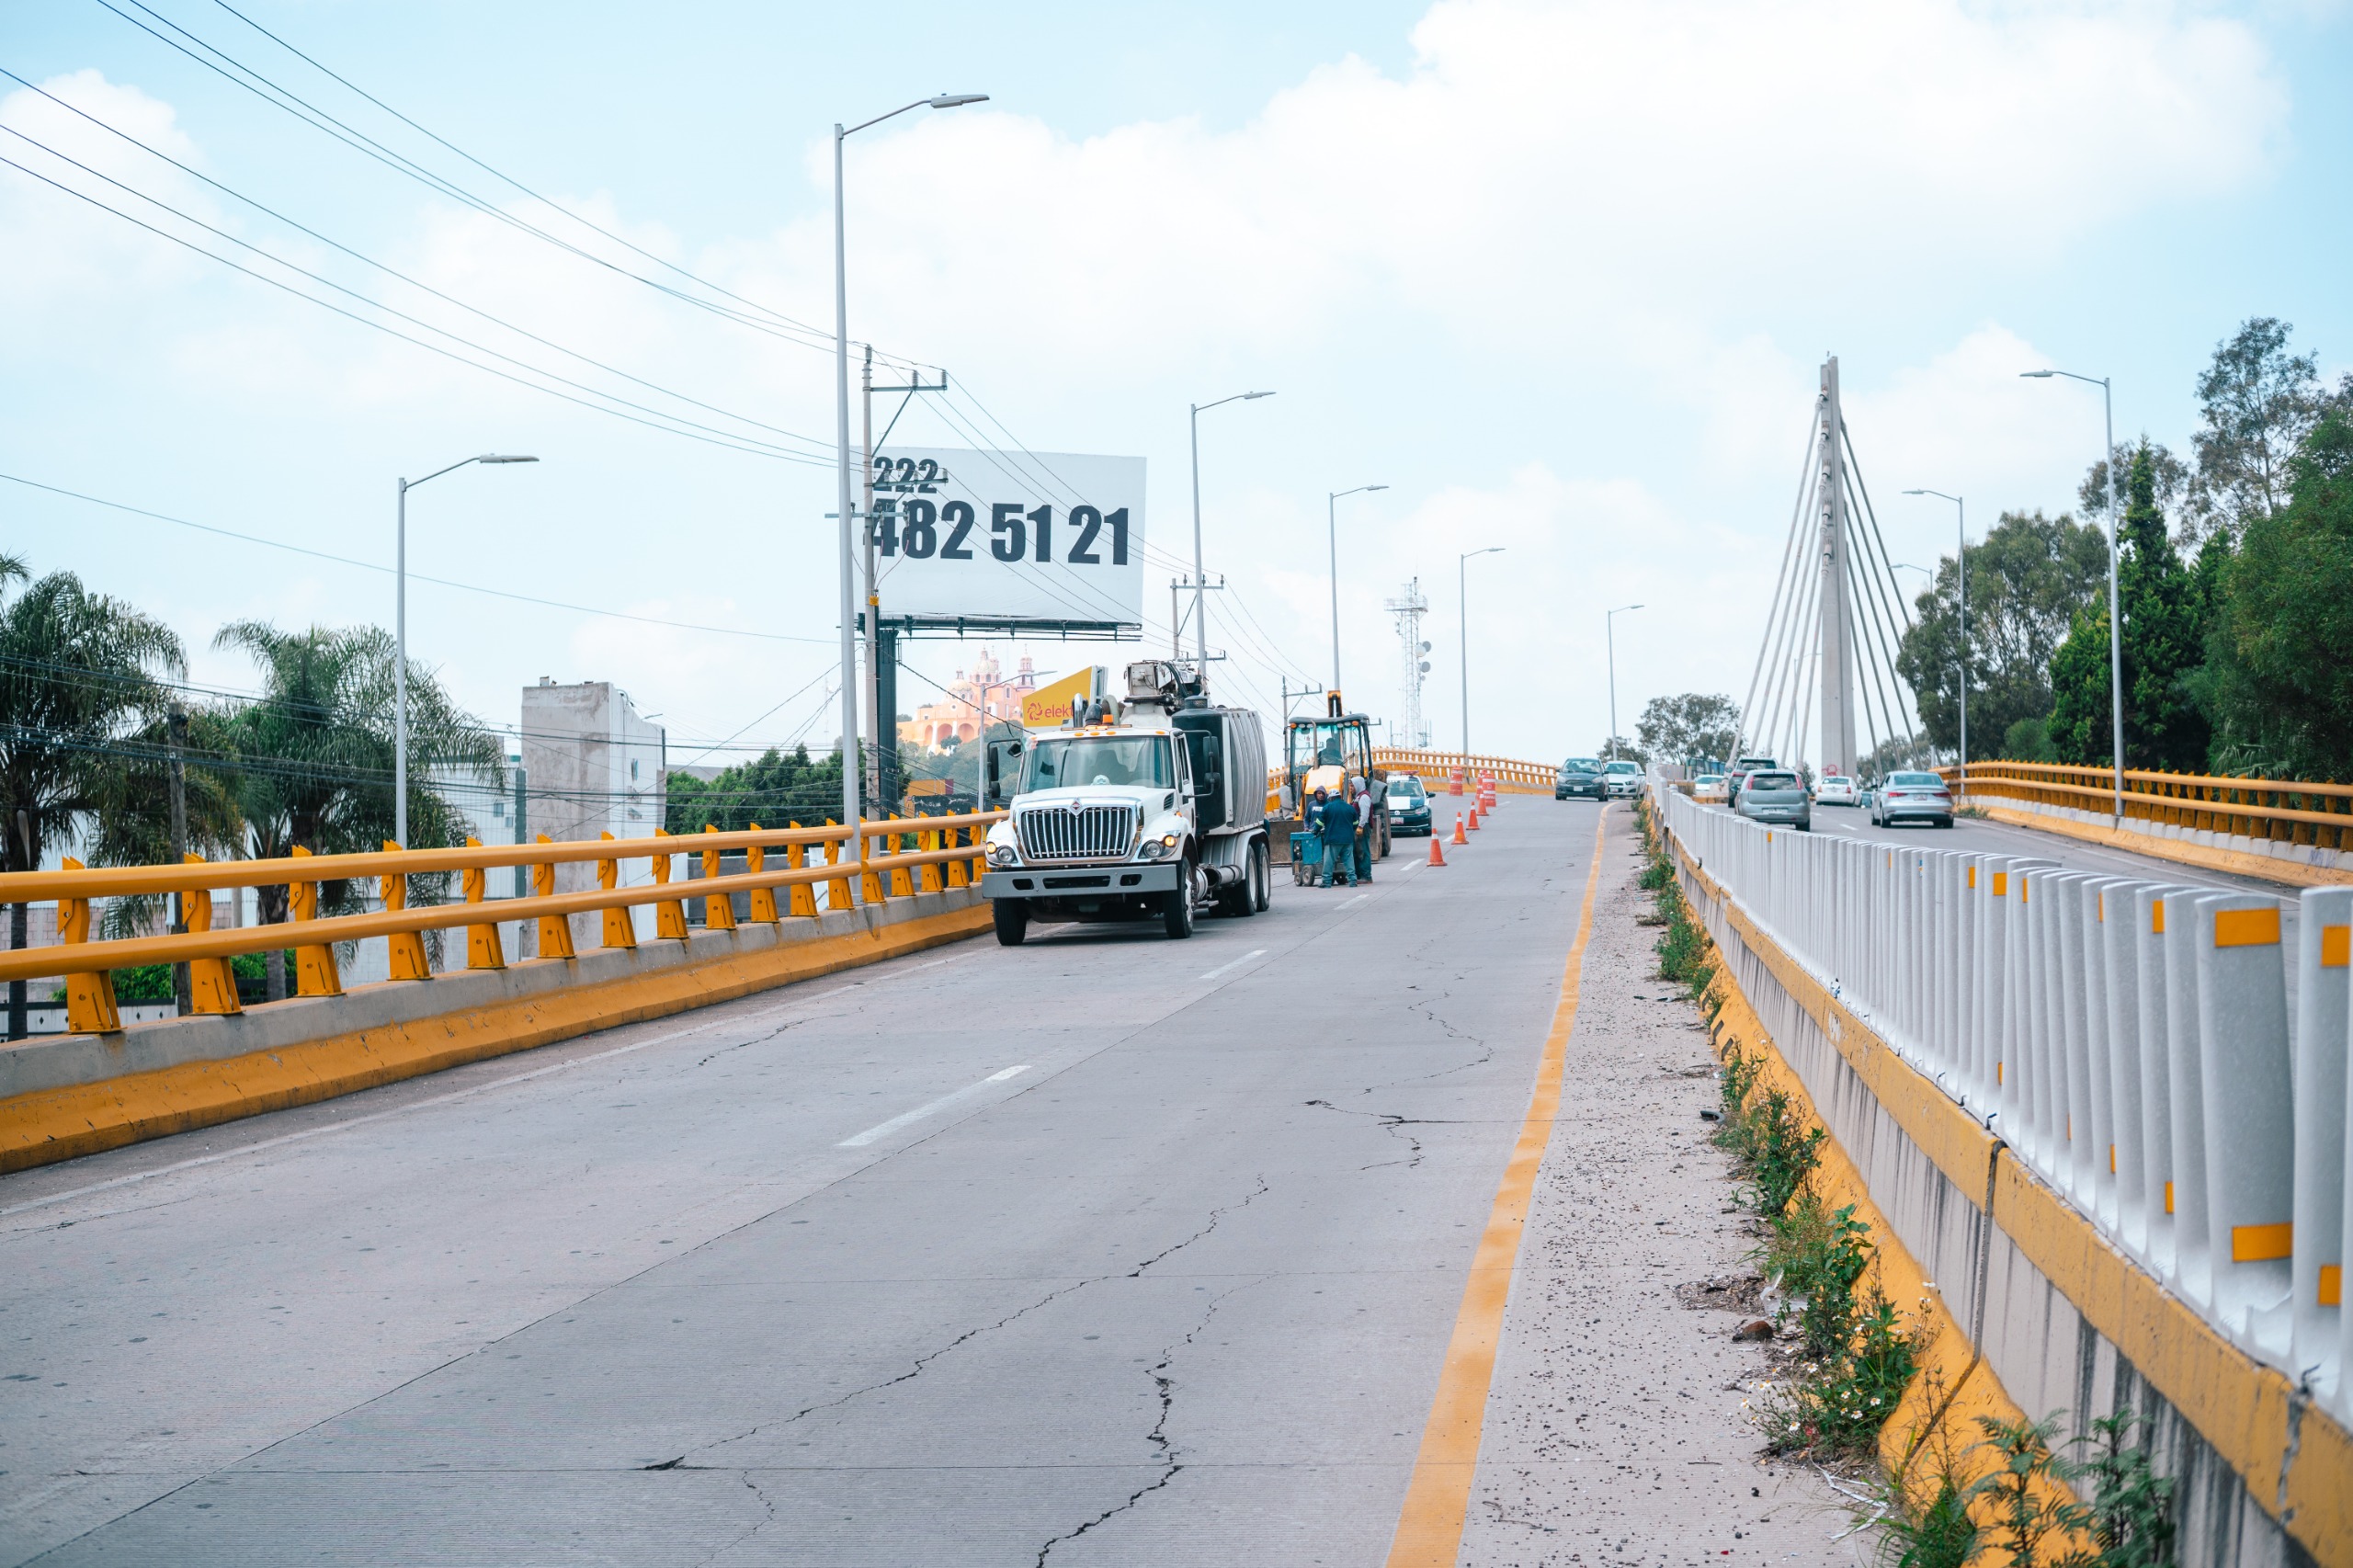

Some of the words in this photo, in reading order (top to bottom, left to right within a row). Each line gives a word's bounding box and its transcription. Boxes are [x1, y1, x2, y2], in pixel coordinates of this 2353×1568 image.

[873, 457, 938, 494] 222
[863, 498, 975, 560] 482
[991, 503, 1051, 563] 51
[1068, 505, 1129, 566] 21
